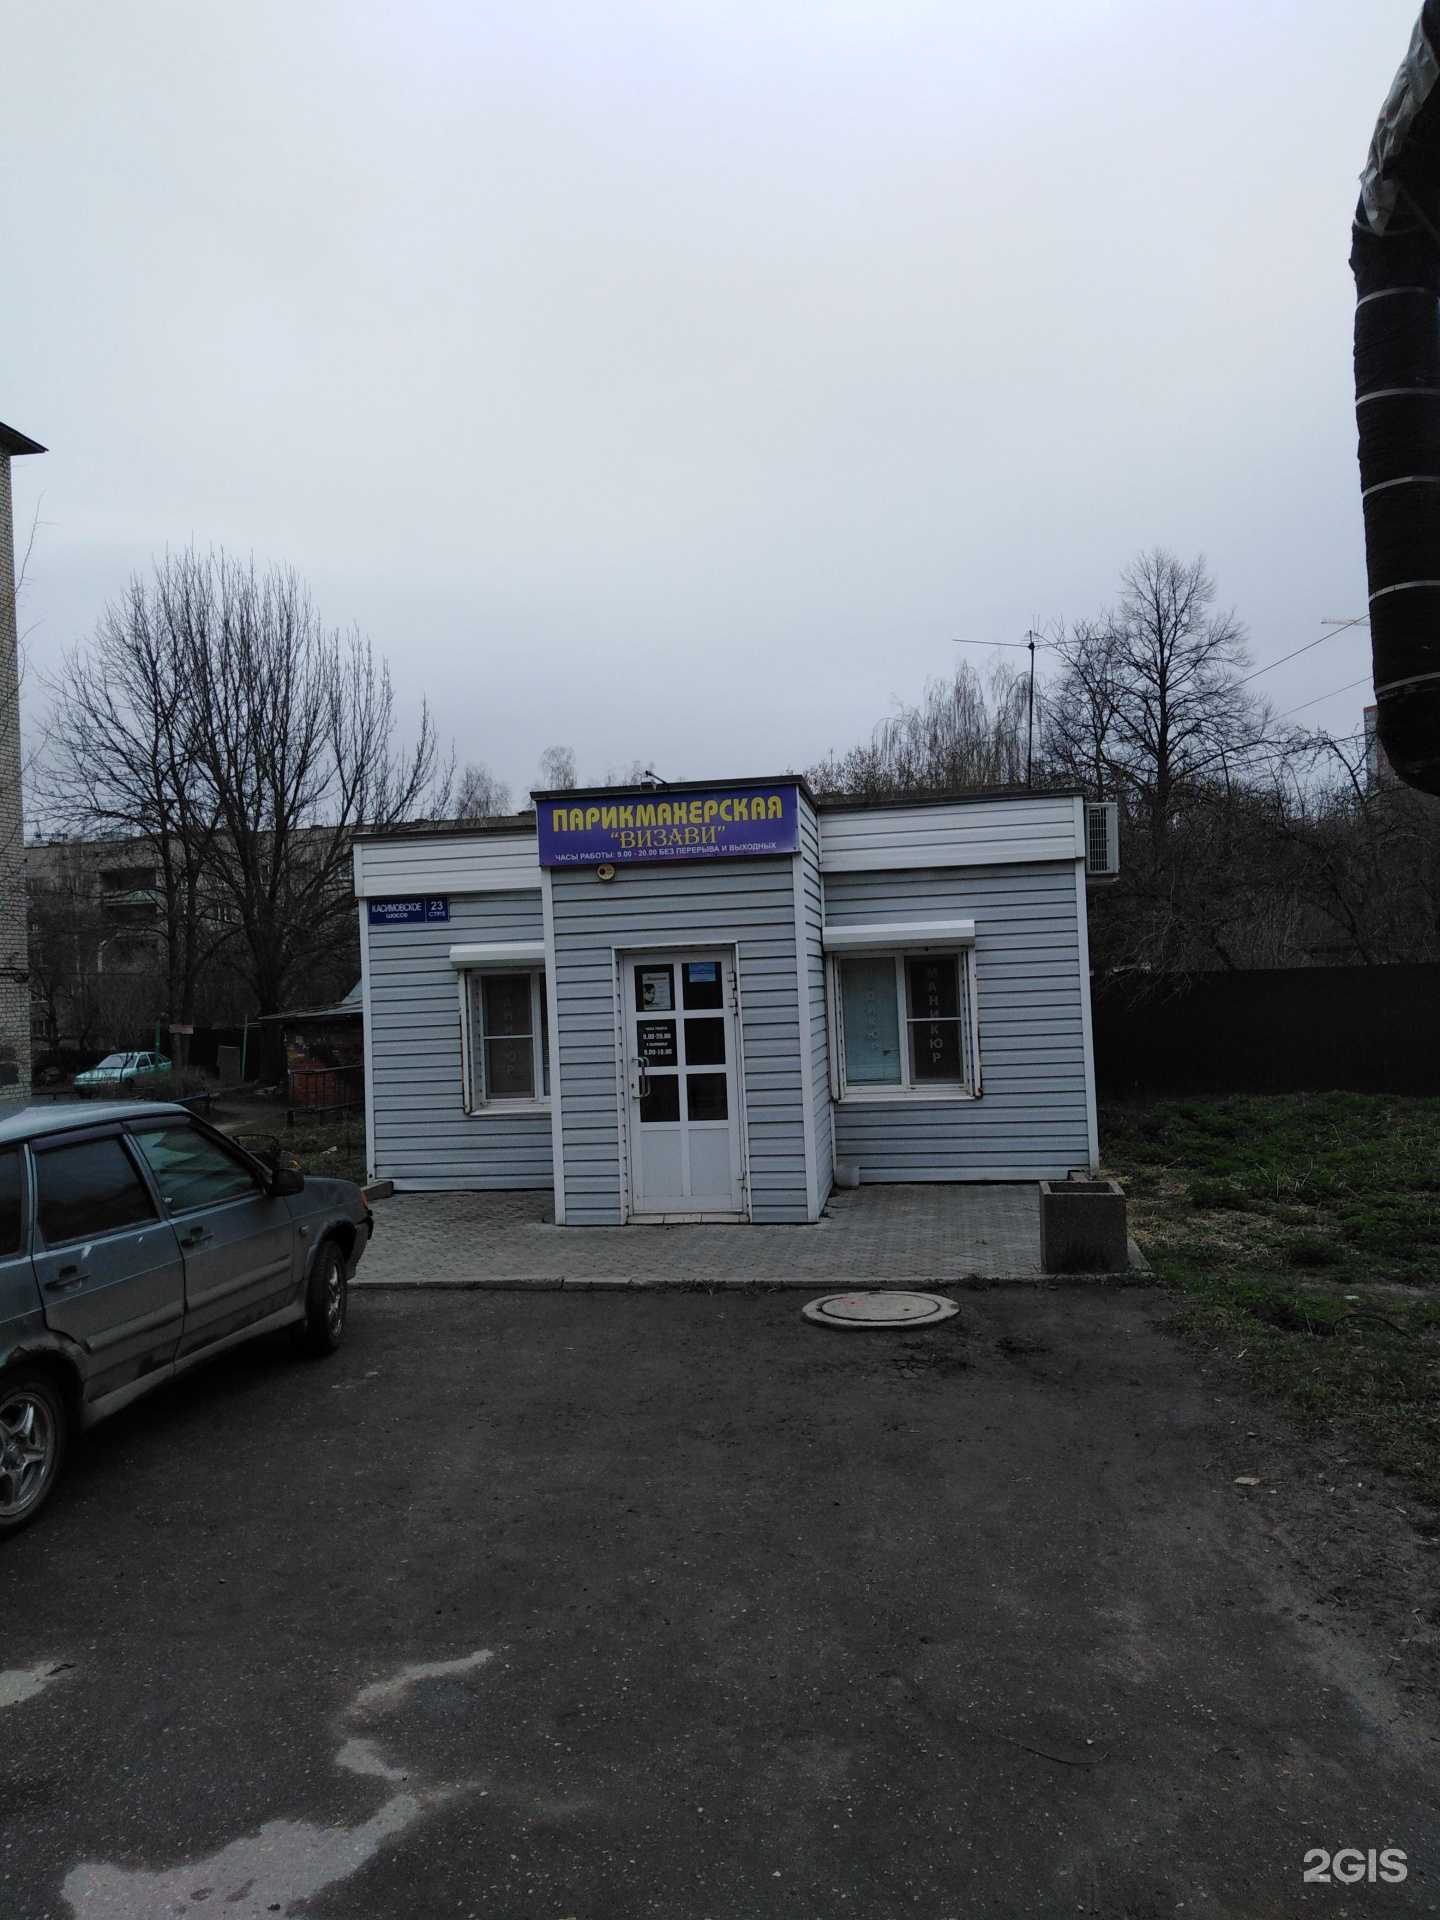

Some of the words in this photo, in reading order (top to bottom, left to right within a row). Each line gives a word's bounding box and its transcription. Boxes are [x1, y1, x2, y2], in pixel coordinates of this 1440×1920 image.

[552, 795, 783, 832] ПАРИКМАХЕРСКАЯ
[555, 853, 579, 862] ЧАСЫ
[638, 849, 657, 857] 20.00
[659, 848, 675, 856] БЕЗ
[676, 845, 720, 854] ПЕРЕРЫВА
[729, 841, 777, 851] ВЫХОДНЫХ
[371, 903, 422, 912] КАСИМОВСКОЕ
[430, 901, 443, 911] 23
